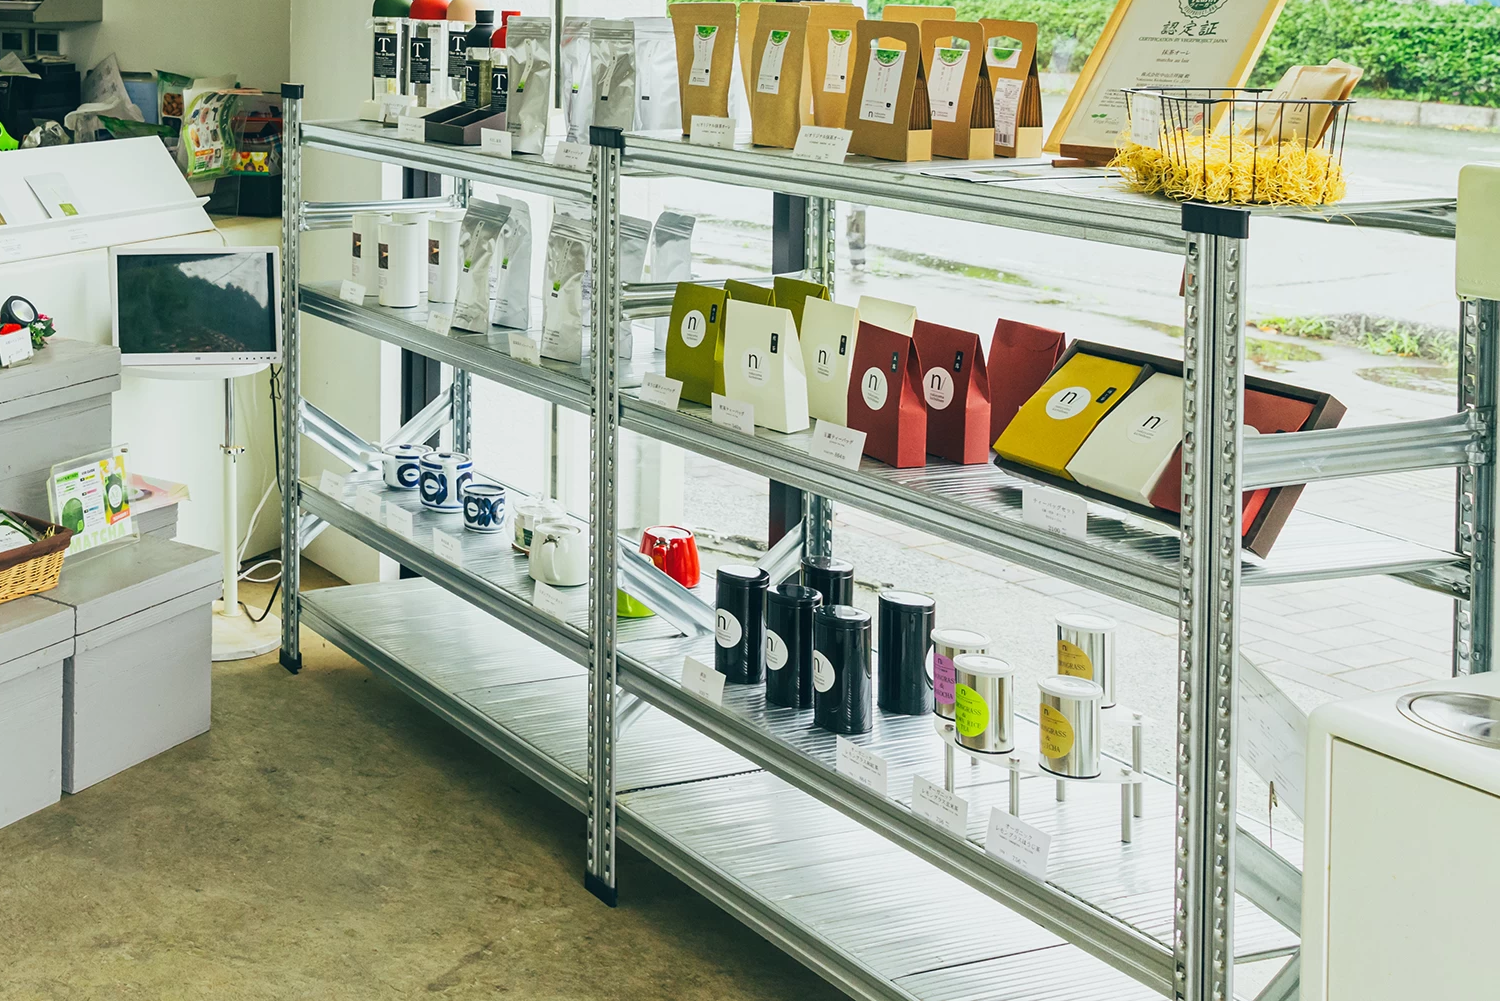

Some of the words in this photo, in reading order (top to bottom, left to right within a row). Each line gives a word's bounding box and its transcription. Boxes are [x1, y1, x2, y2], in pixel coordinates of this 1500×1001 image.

[1161, 20, 1220, 36] 認定証
[69, 522, 126, 555] MATCHA
[1005, 823, 1033, 841] オーガニック
